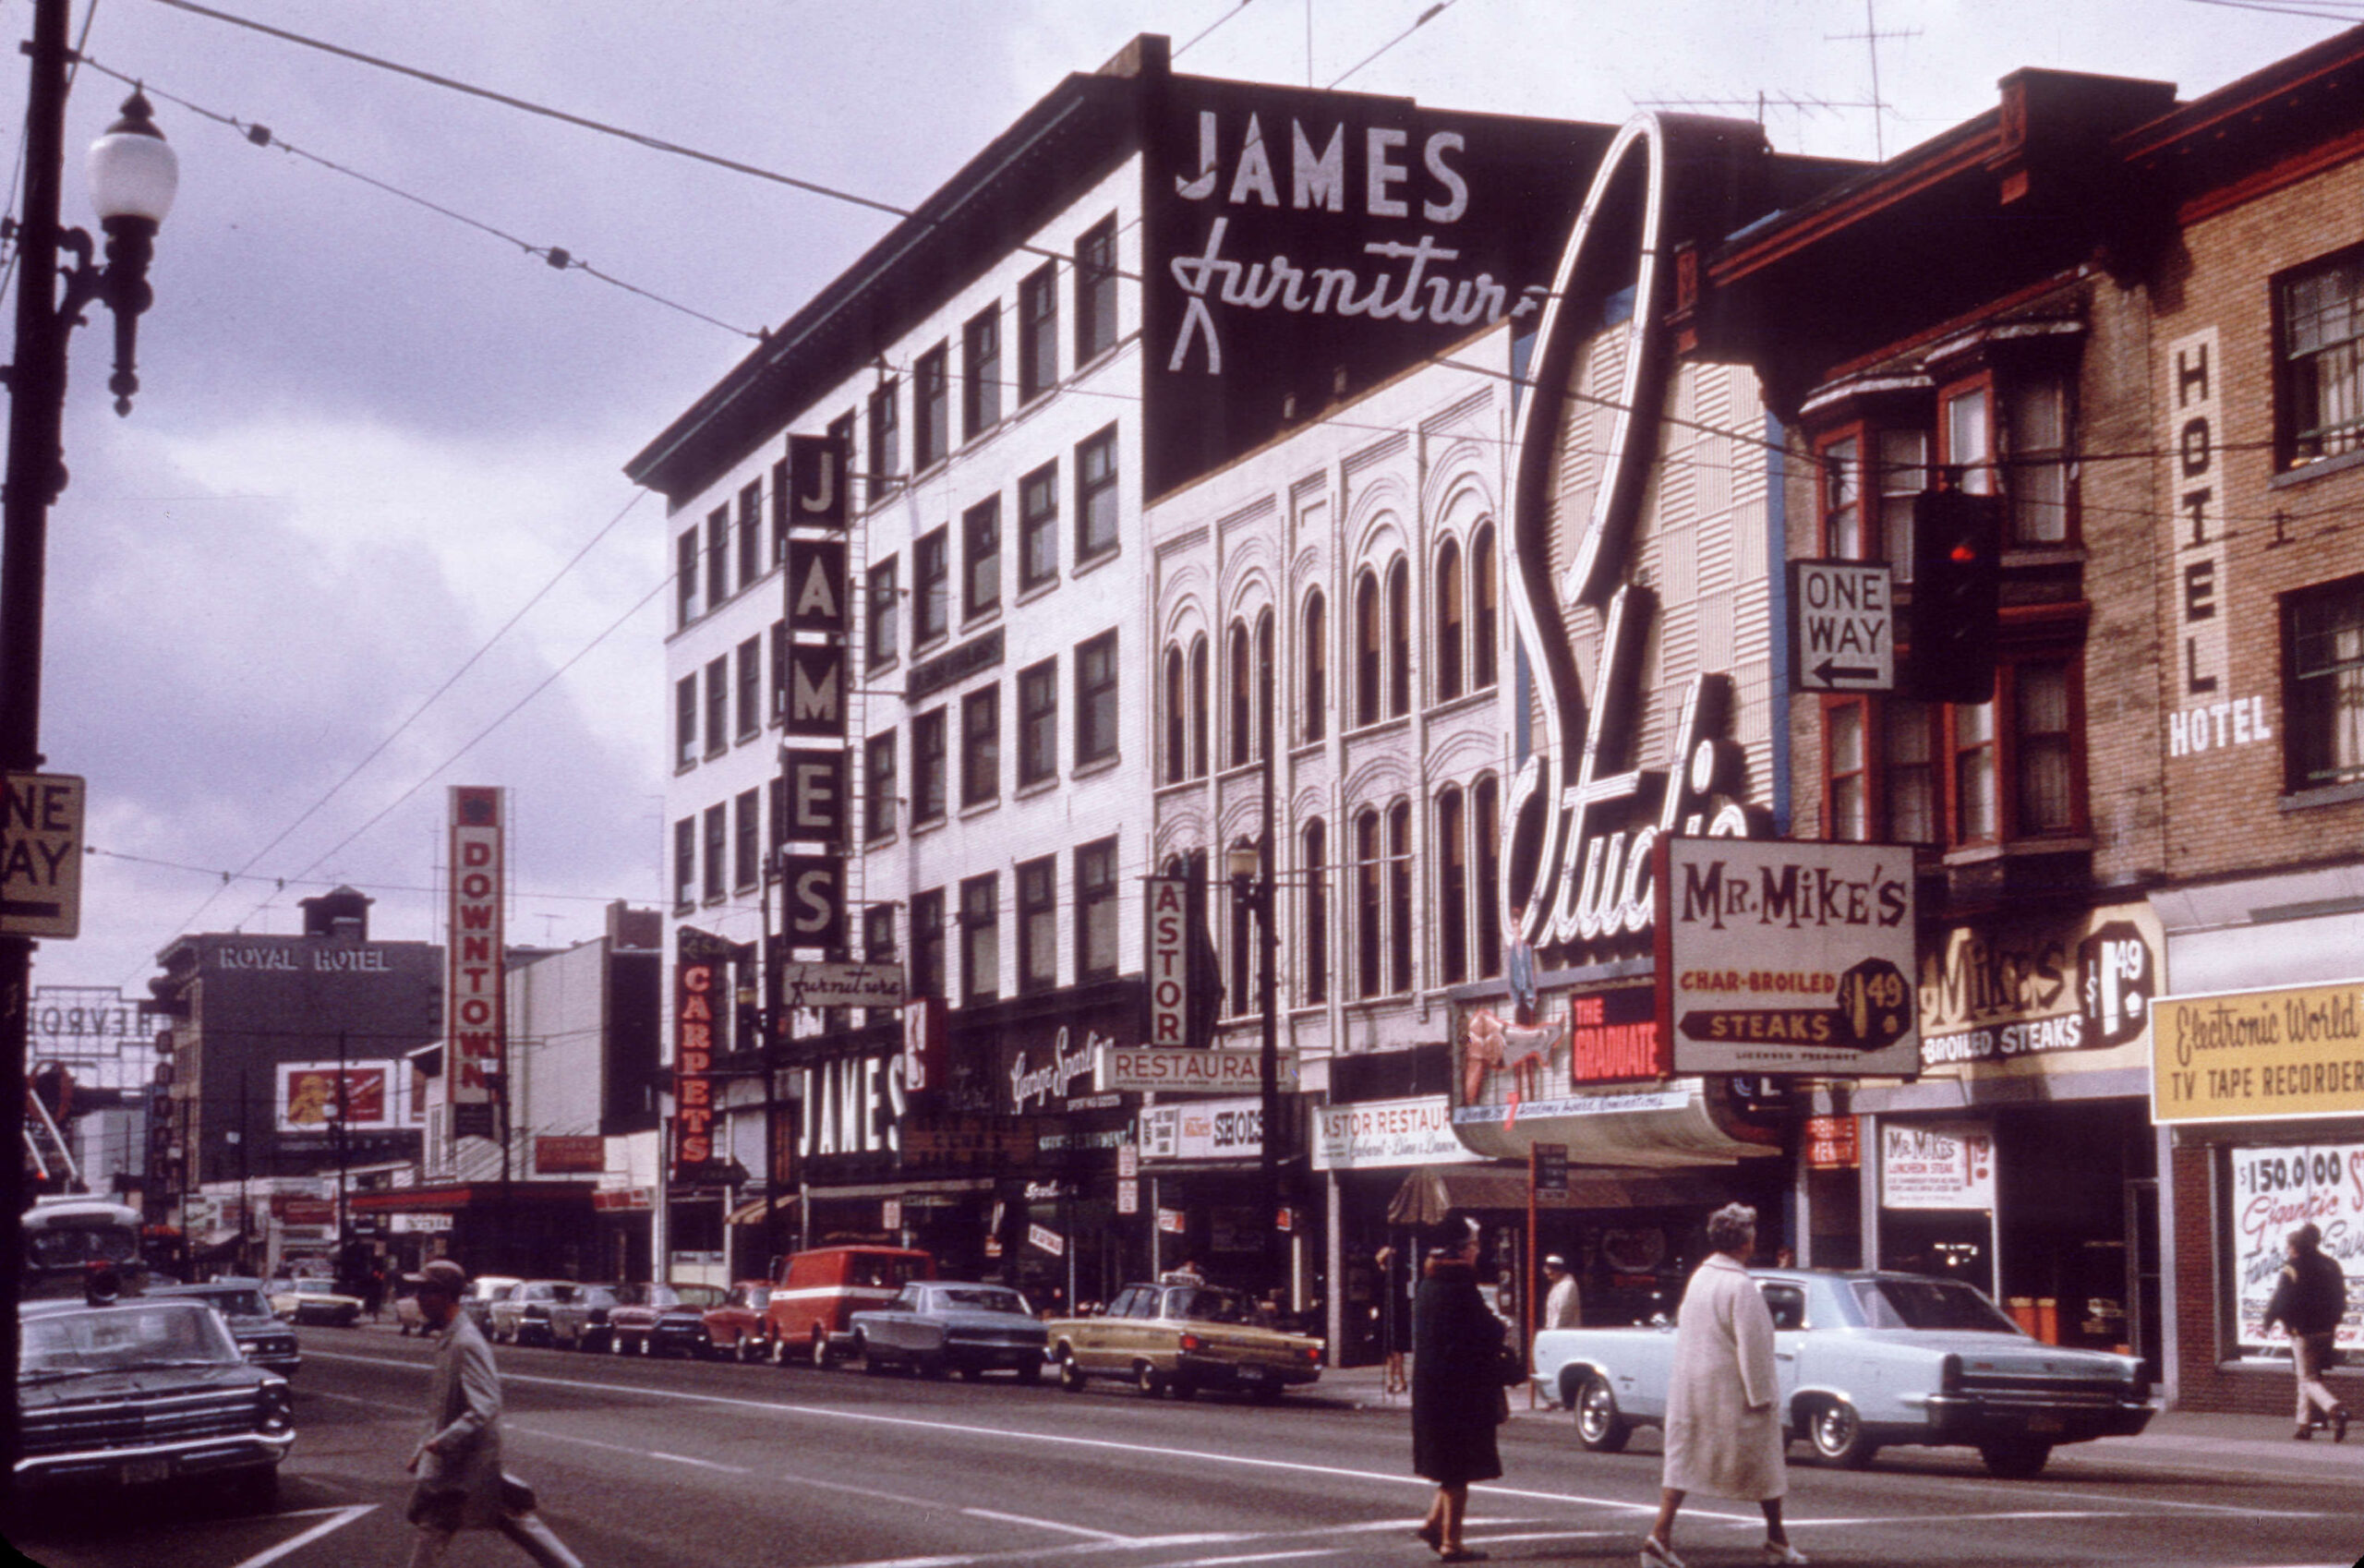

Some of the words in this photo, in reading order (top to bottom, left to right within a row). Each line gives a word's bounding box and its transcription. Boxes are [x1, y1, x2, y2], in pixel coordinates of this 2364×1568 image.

[1176, 111, 1468, 223] JAMES
[2177, 344, 2217, 694] HOTEL
[1807, 572, 1883, 610] ONE
[1808, 616, 1885, 654] WAY
[793, 452, 838, 932] JAMES
[2170, 695, 2271, 756] HOTEL
[220, 947, 298, 970] ROYAL
[315, 950, 392, 971] HOTEL
[461, 841, 492, 1089] DOWNTOWN
[1156, 885, 1182, 1042] ASTOR
[1680, 971, 1836, 994] CHAR-BROILED
[791, 963, 900, 1010] furniture
[1574, 997, 1603, 1026] THE
[1574, 1020, 1658, 1080] GRADUATE
[1710, 1015, 1831, 1042] STEAKS
[2000, 1014, 2082, 1054] STEAKS
[2176, 1003, 2281, 1067] Electronic
[2286, 993, 2360, 1043] World
[682, 967, 711, 1162] CARPETS
[1115, 1055, 1289, 1079] RESTAURAT
[2172, 1071, 2196, 1101] TV
[2208, 1067, 2252, 1099] TAPE
[800, 1054, 908, 1157] JAMES
[1322, 1114, 1372, 1139] ASTOR
[2243, 1189, 2339, 1253] Gigantic
